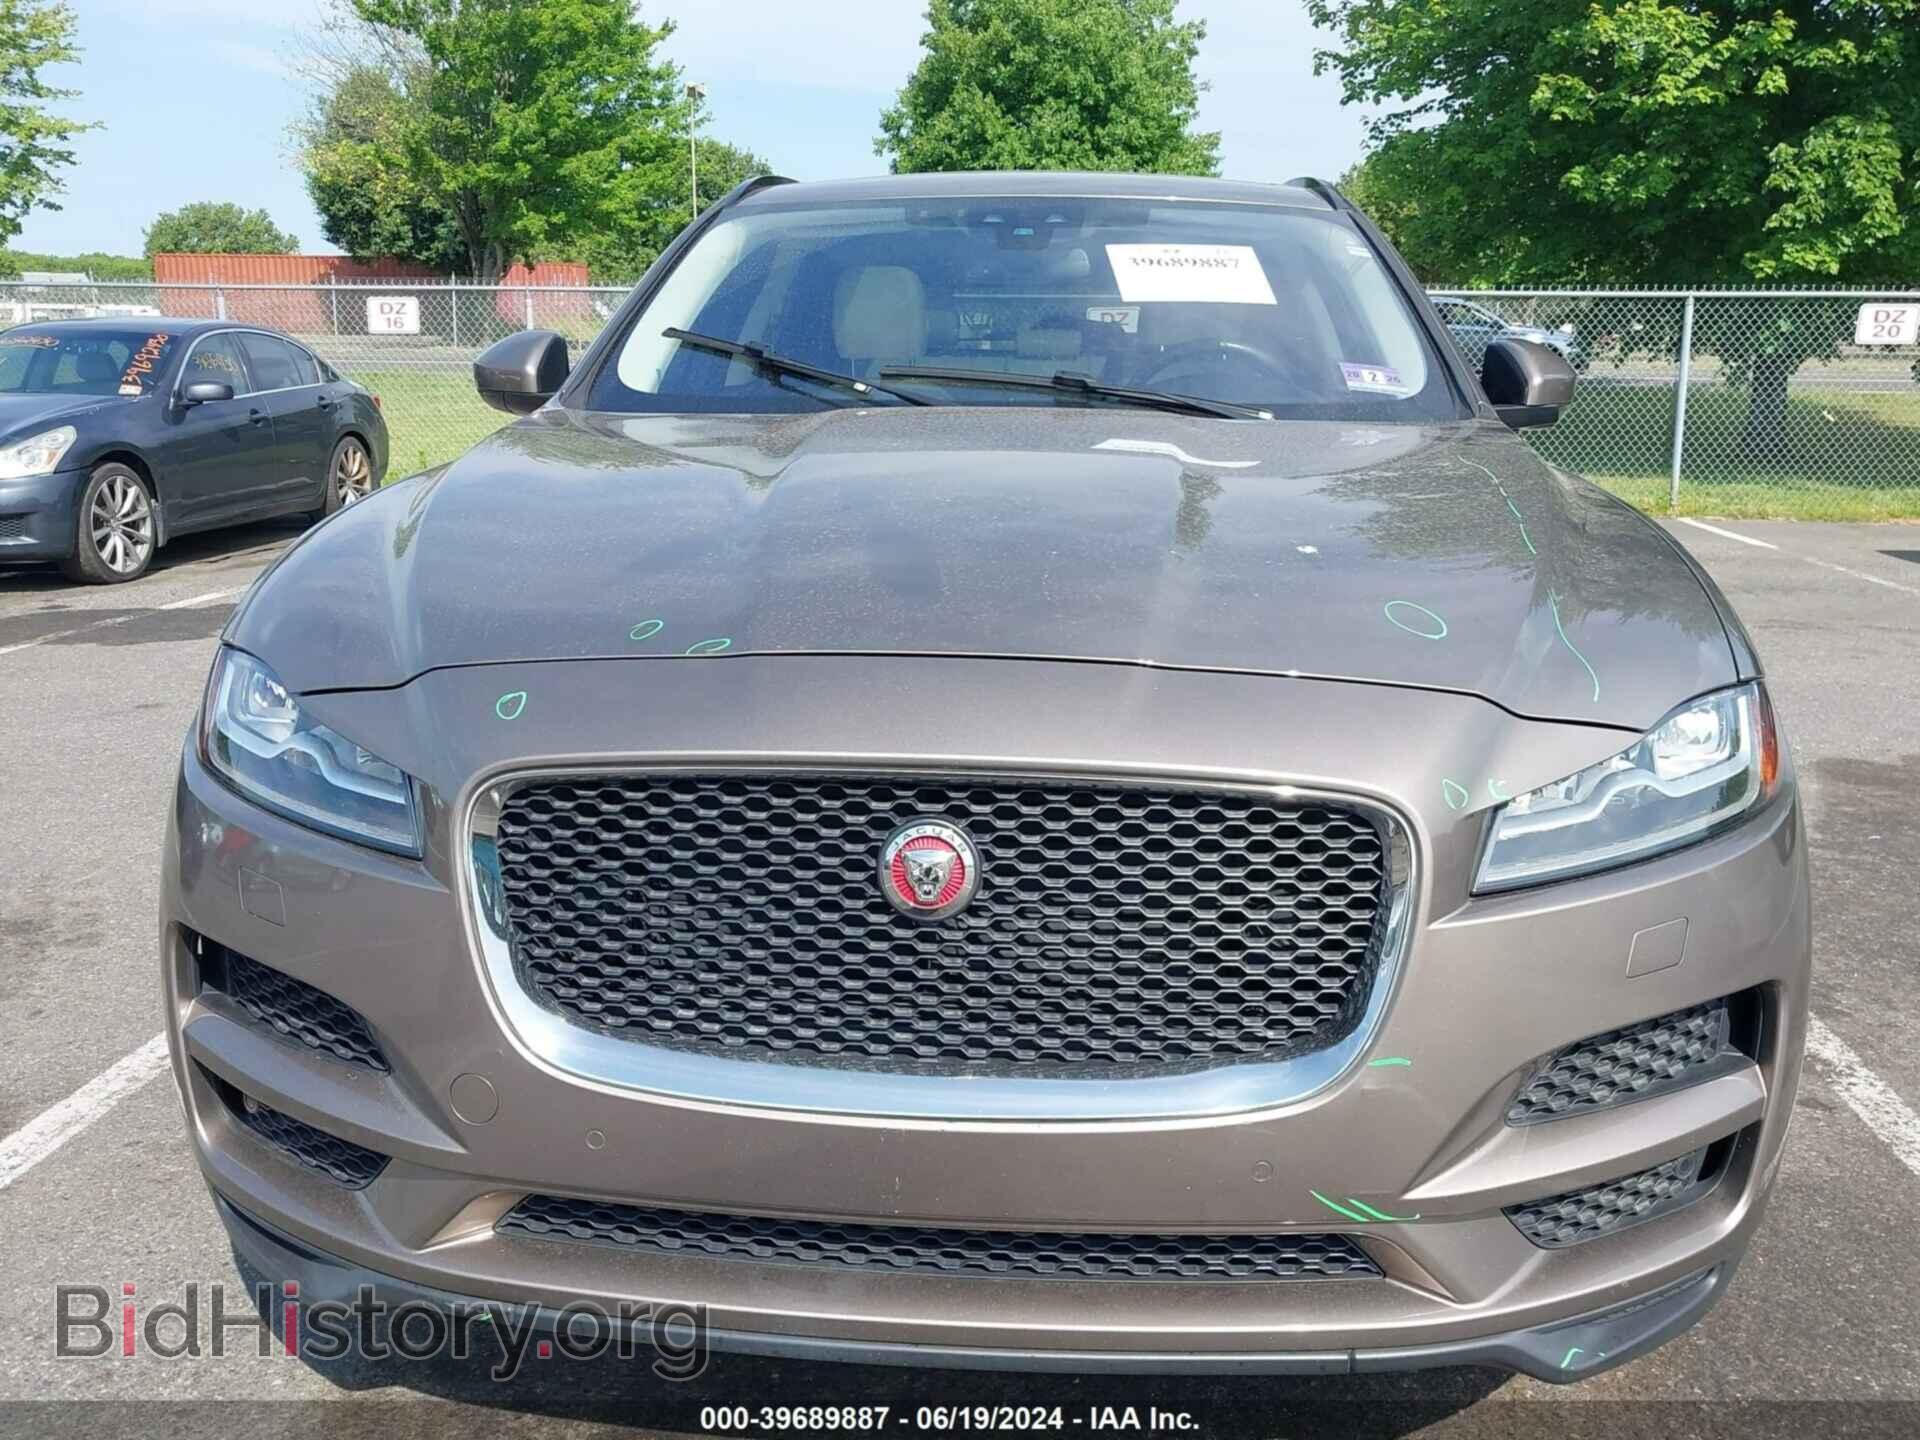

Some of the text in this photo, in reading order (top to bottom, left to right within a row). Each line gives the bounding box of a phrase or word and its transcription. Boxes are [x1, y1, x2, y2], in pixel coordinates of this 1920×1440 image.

[379, 302, 408, 315] DZ
[385, 316, 405, 329] 16
[1100, 312, 1130, 326] DZ
[1873, 309, 1907, 324] DZ
[1872, 324, 1901, 338] 20
[891, 827, 968, 854] JAGUAR
